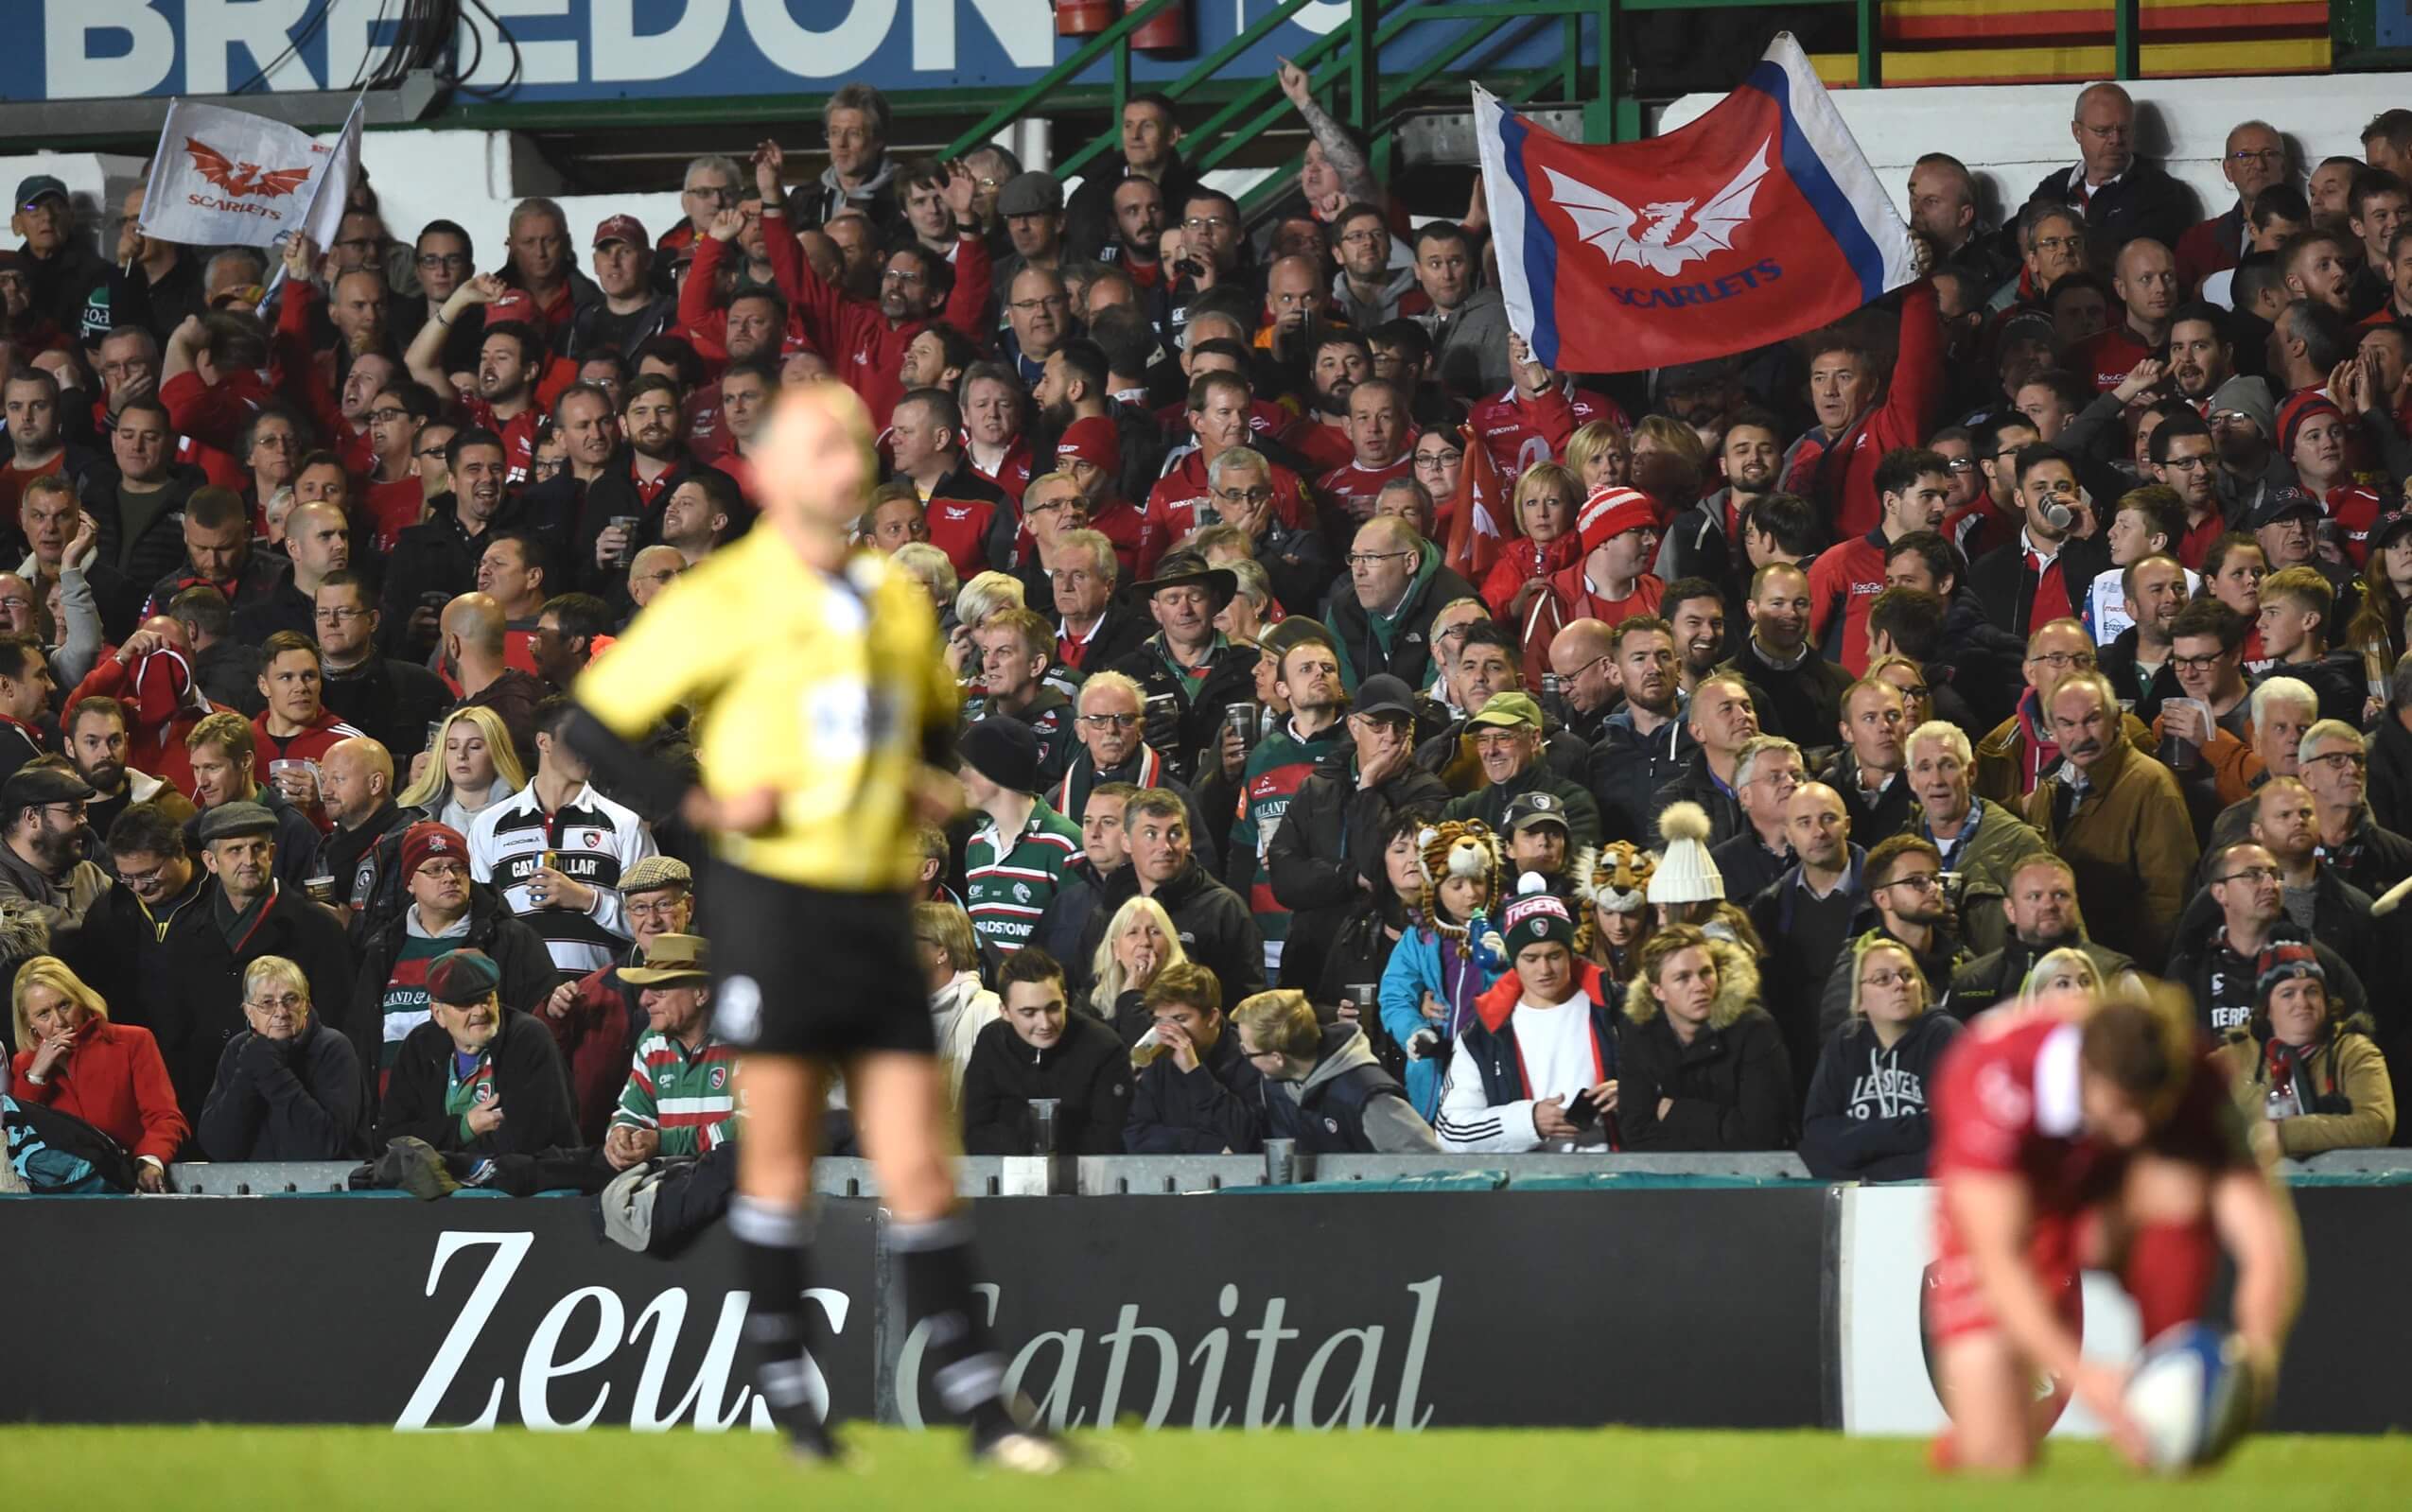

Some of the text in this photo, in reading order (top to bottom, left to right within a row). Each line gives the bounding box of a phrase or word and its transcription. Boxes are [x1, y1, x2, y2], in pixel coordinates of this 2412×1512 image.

[188, 194, 283, 220] SCARLETS
[1609, 257, 1783, 309] SCARLETS
[393, 1231, 849, 1432] Zeus
